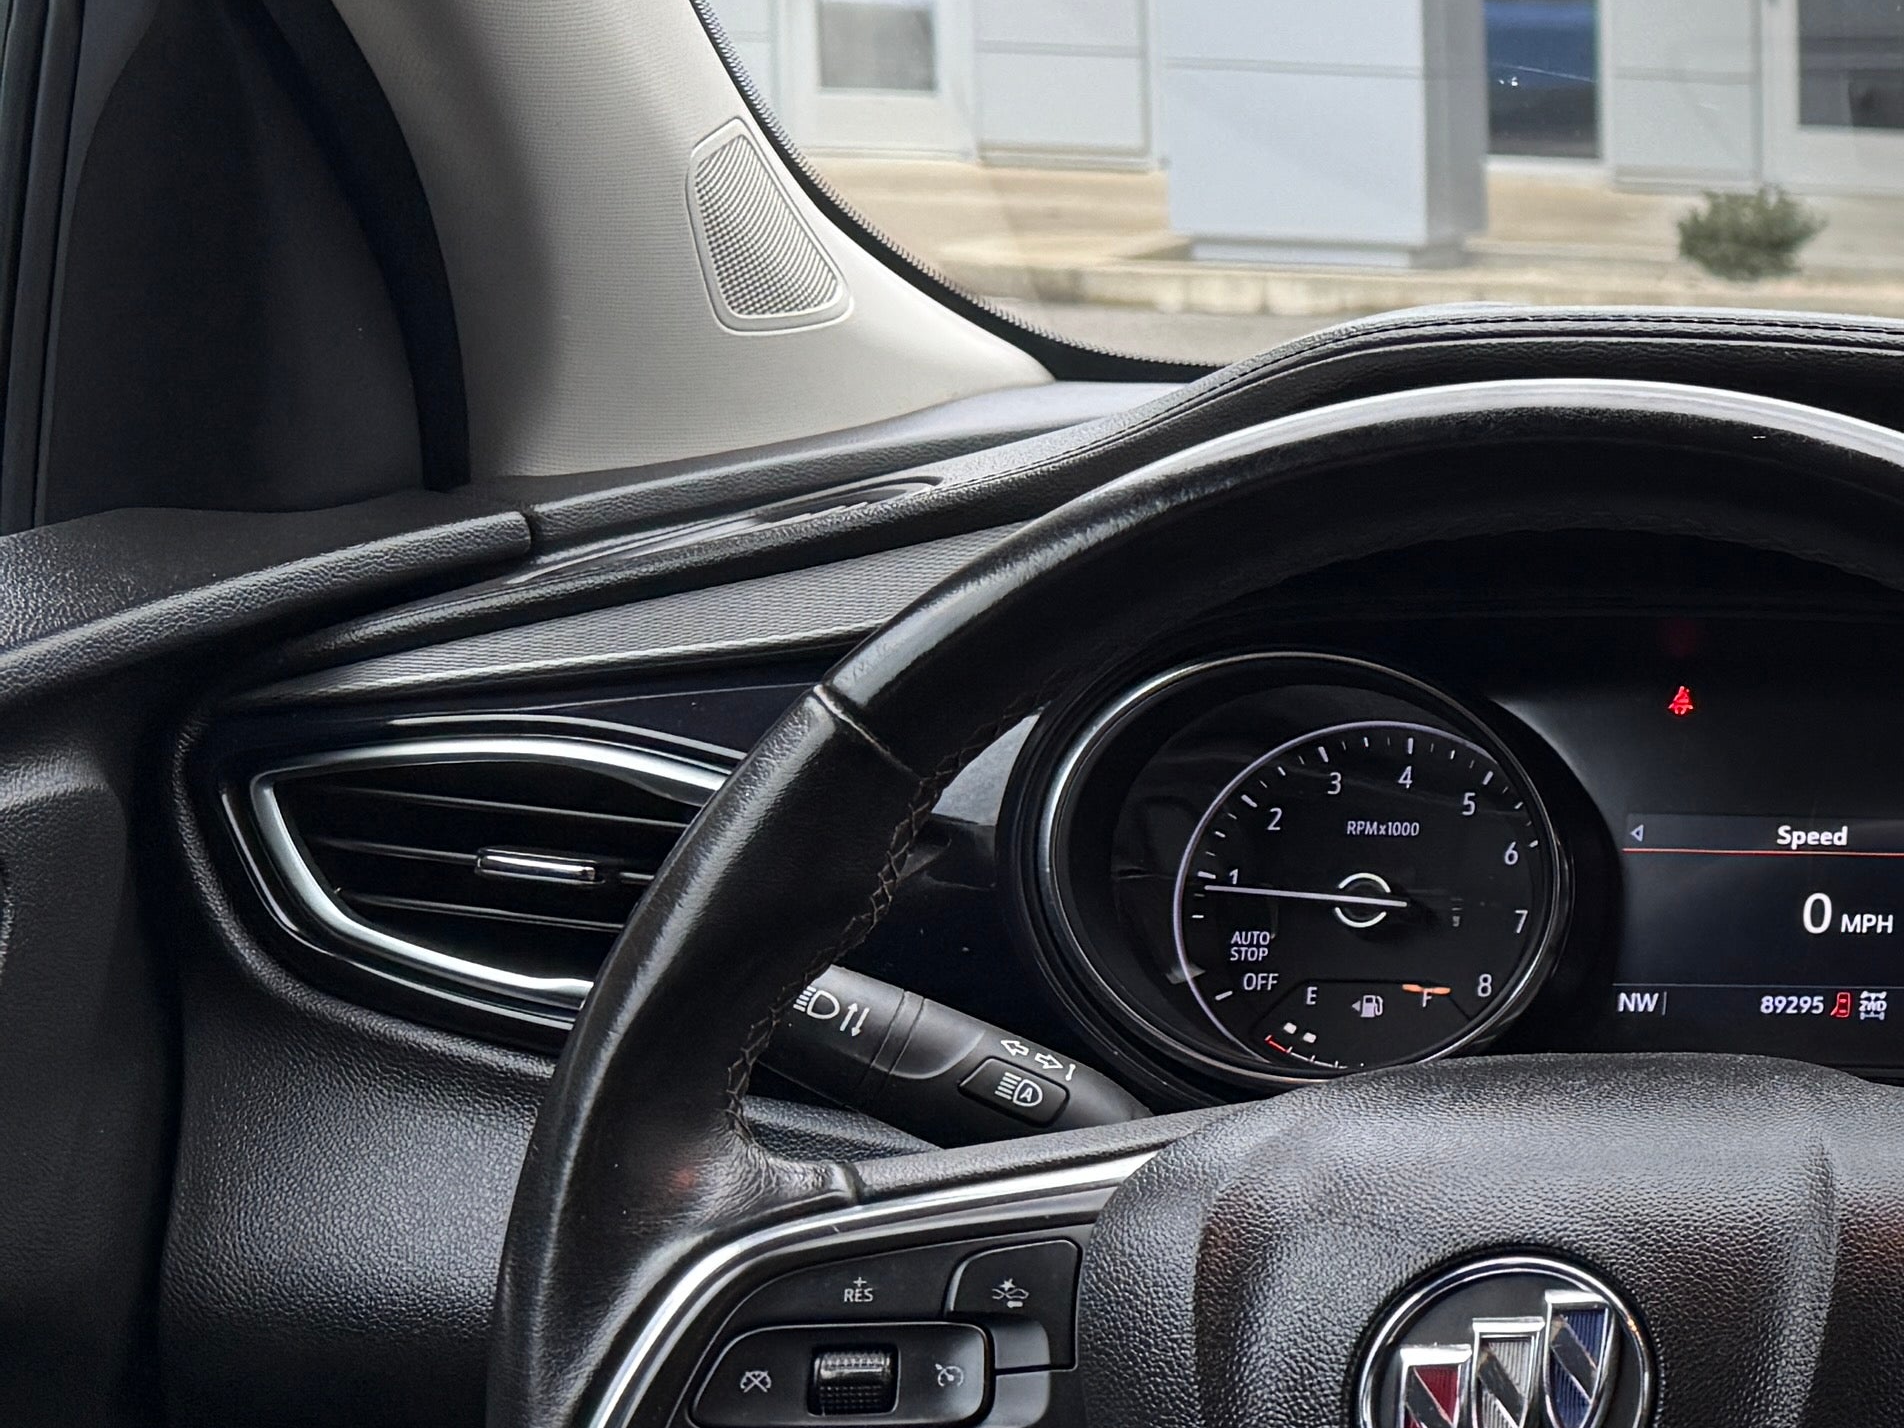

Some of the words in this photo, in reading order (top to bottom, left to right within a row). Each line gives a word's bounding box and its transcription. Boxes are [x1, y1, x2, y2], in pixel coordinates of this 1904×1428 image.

[1326, 772, 1342, 795] 3
[1397, 765, 1413, 789] 4
[1461, 792, 1476, 816] 5
[1267, 807, 1283, 831] 2
[1346, 821, 1420, 837] RPMx1000
[1776, 824, 1849, 850] Speed
[1504, 842, 1519, 865] 6
[1229, 869, 1239, 884] 1
[1513, 909, 1529, 934] 7
[1803, 892, 1832, 934] 0
[1840, 913, 1894, 934] MPH
[1230, 930, 1271, 946] AUTO
[1229, 947, 1269, 962] STOP
[1242, 972, 1279, 991] OFF
[1477, 973, 1493, 998] 8
[1306, 987, 1318, 1005] E
[1422, 989, 1433, 1007] F
[1617, 992, 1659, 1013] NW
[1760, 994, 1825, 1015] 89295
[843, 1287, 874, 1303] RES
